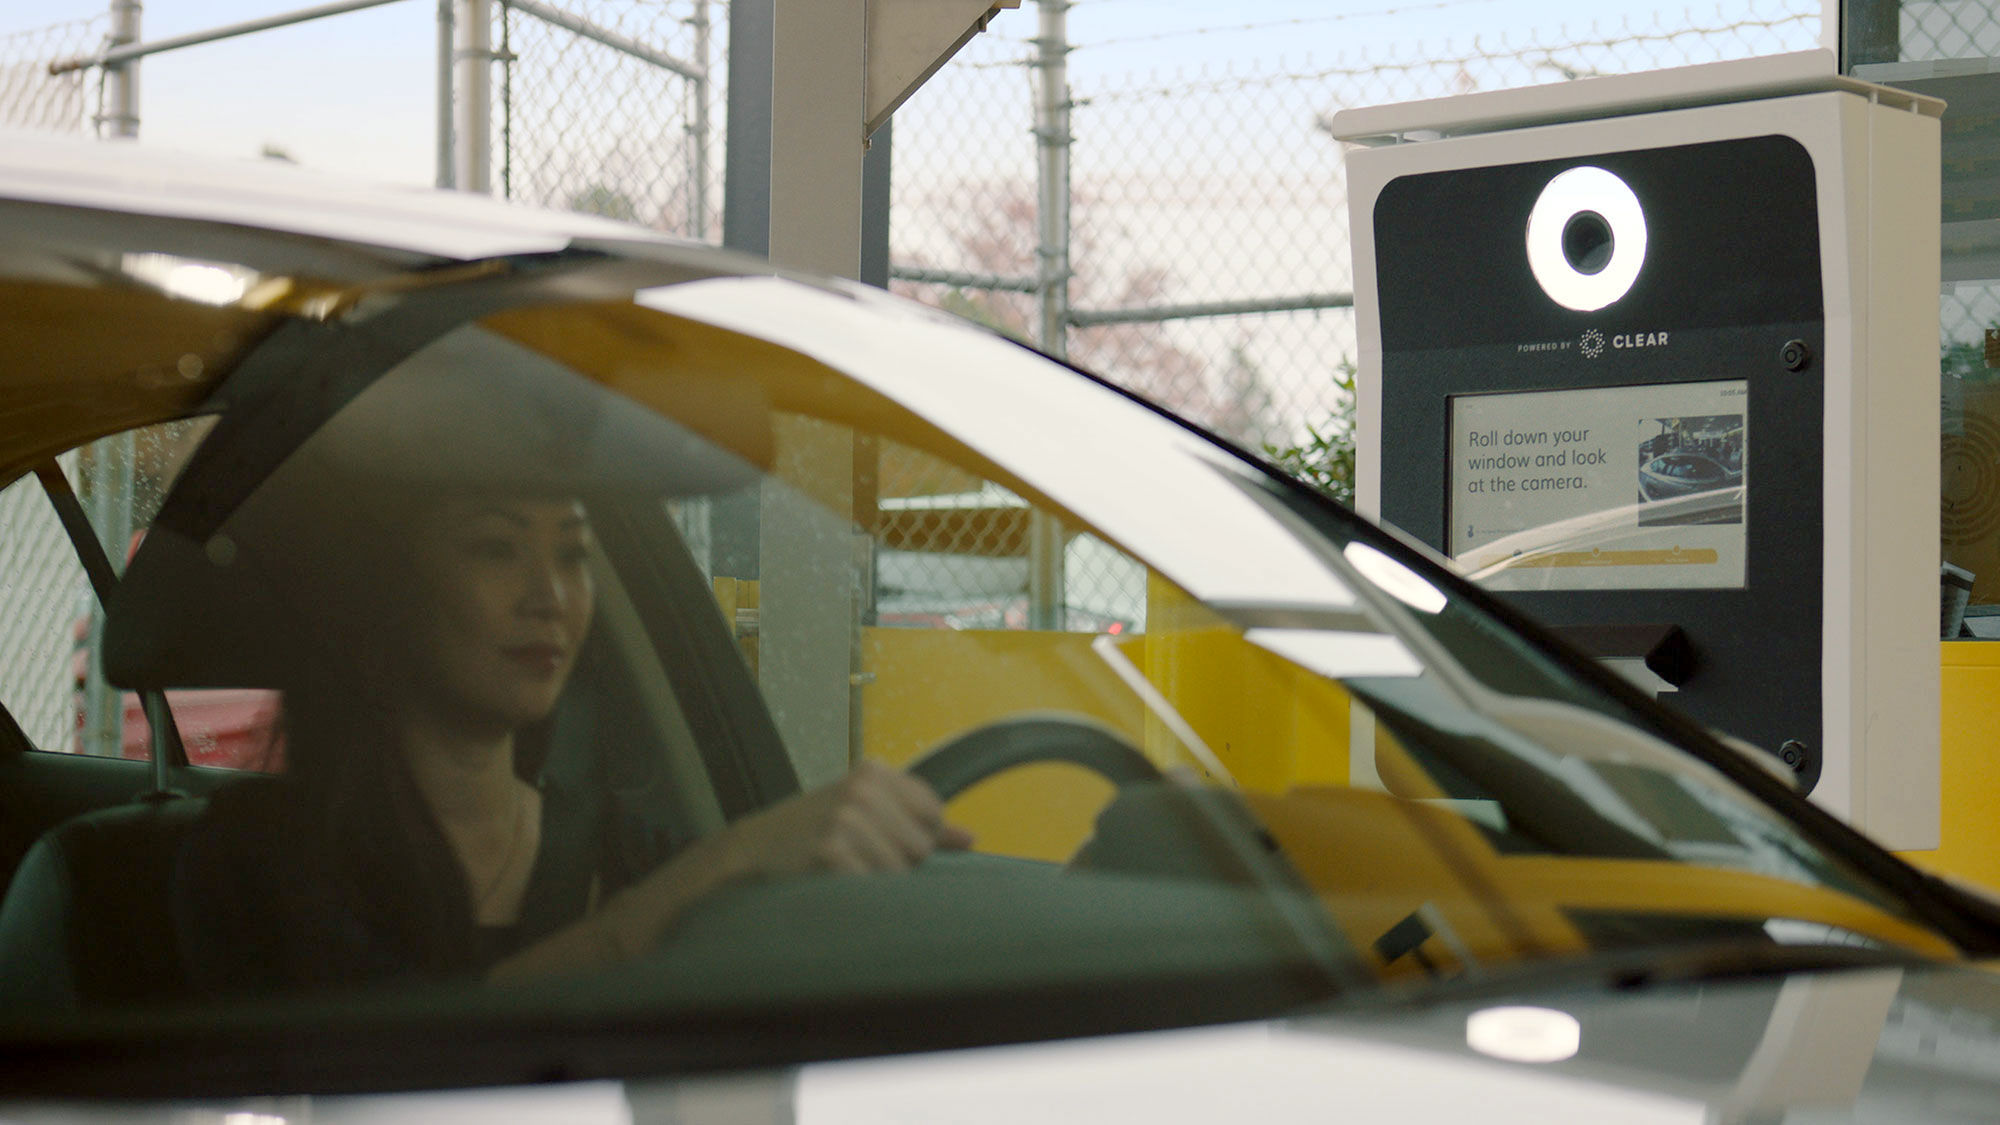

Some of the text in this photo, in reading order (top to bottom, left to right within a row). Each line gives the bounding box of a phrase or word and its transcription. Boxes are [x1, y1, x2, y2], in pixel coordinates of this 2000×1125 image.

[1517, 331, 1668, 352] POWERED BY CLEAR
[1469, 429, 1590, 447] Roll down your
[1468, 448, 1607, 470] window and look
[1467, 476, 1588, 493] at the camera.
